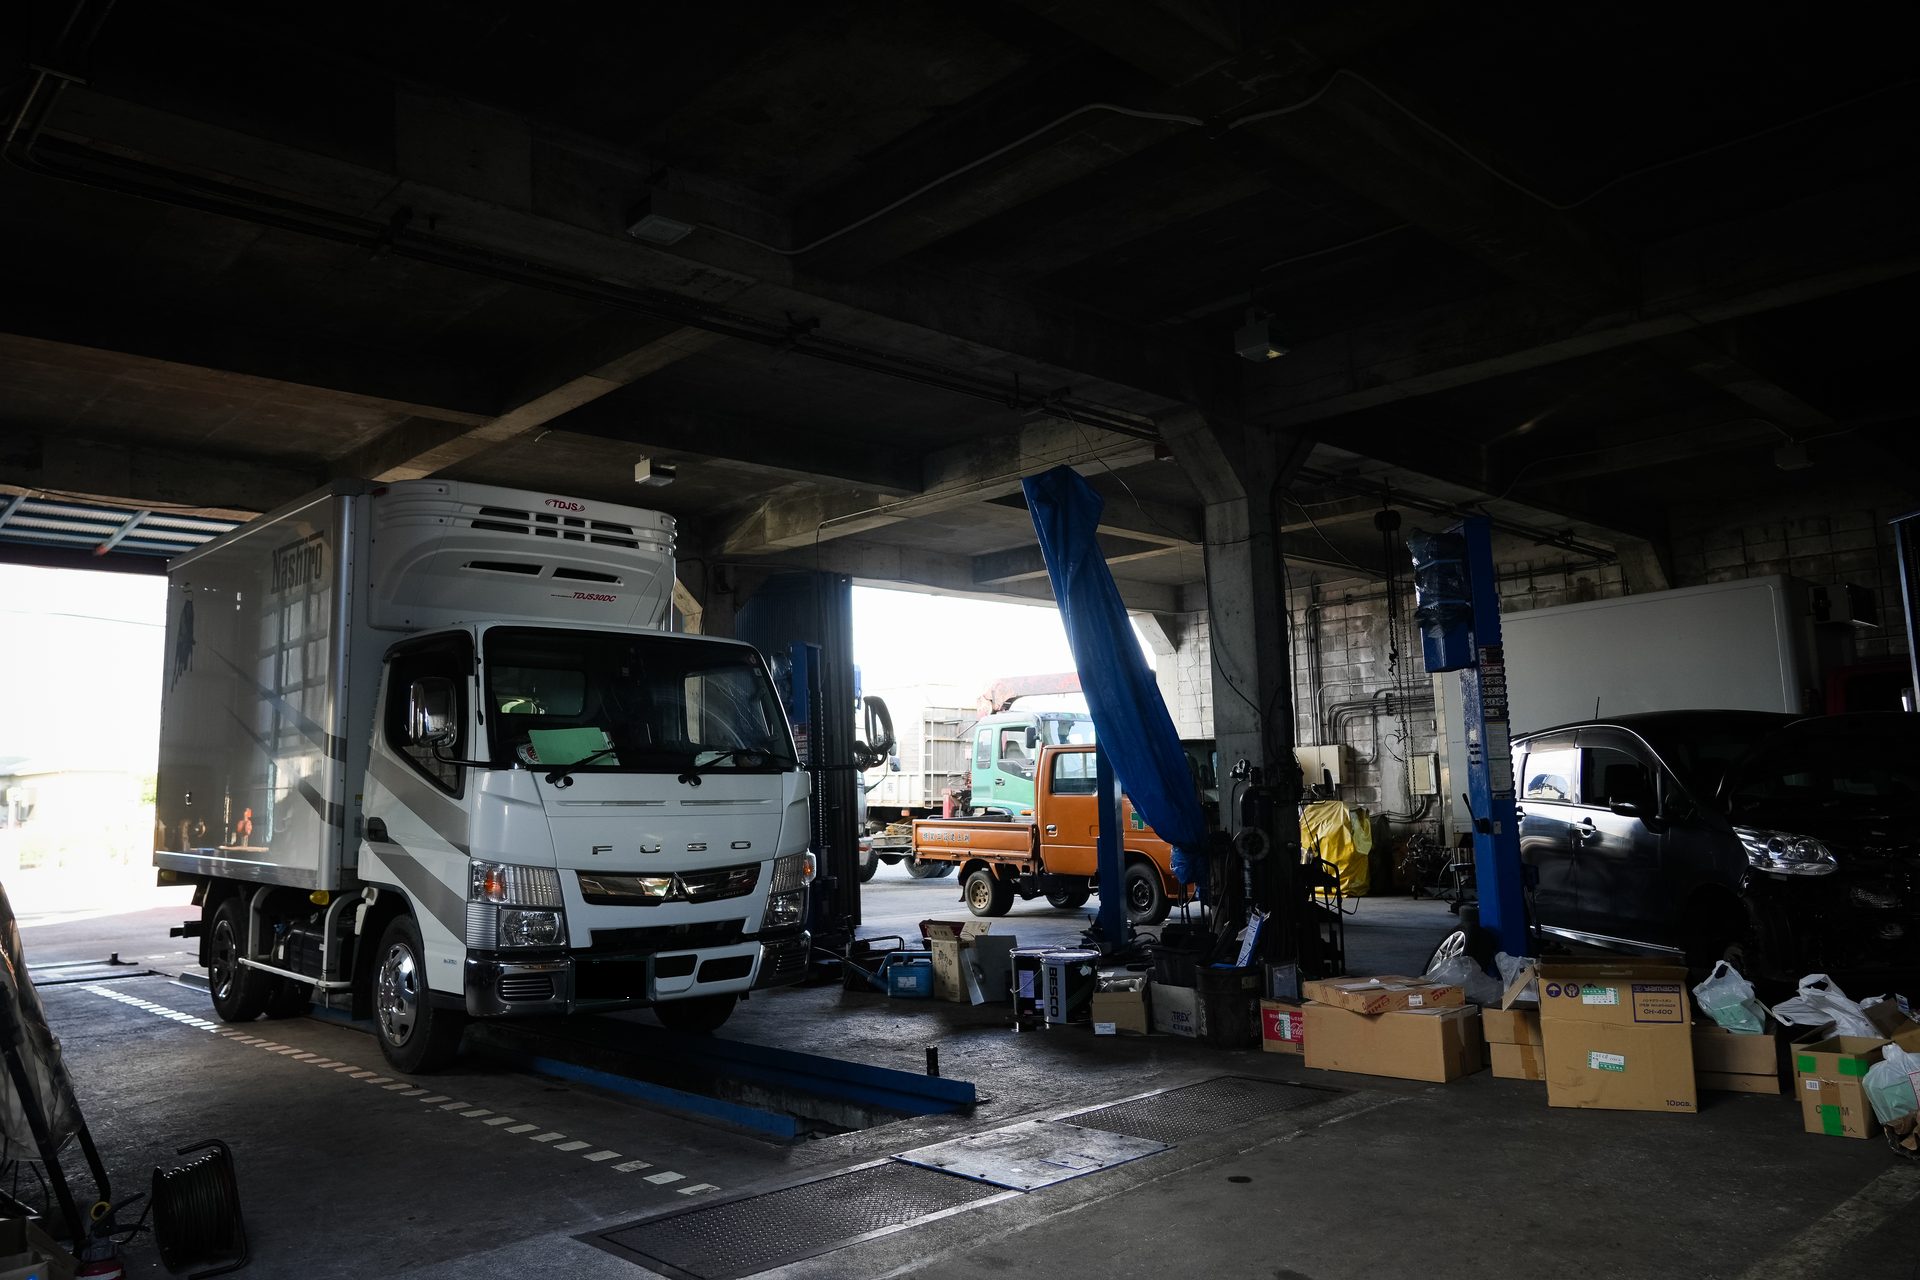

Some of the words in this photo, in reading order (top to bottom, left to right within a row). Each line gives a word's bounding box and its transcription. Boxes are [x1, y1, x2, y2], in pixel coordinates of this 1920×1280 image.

[552, 500, 579, 511] TDJS
[271, 530, 325, 595] Nashiro
[572, 592, 617, 602] TDJS30DC
[592, 840, 752, 855] FUSO
[1048, 966, 1059, 1018] BESCO
